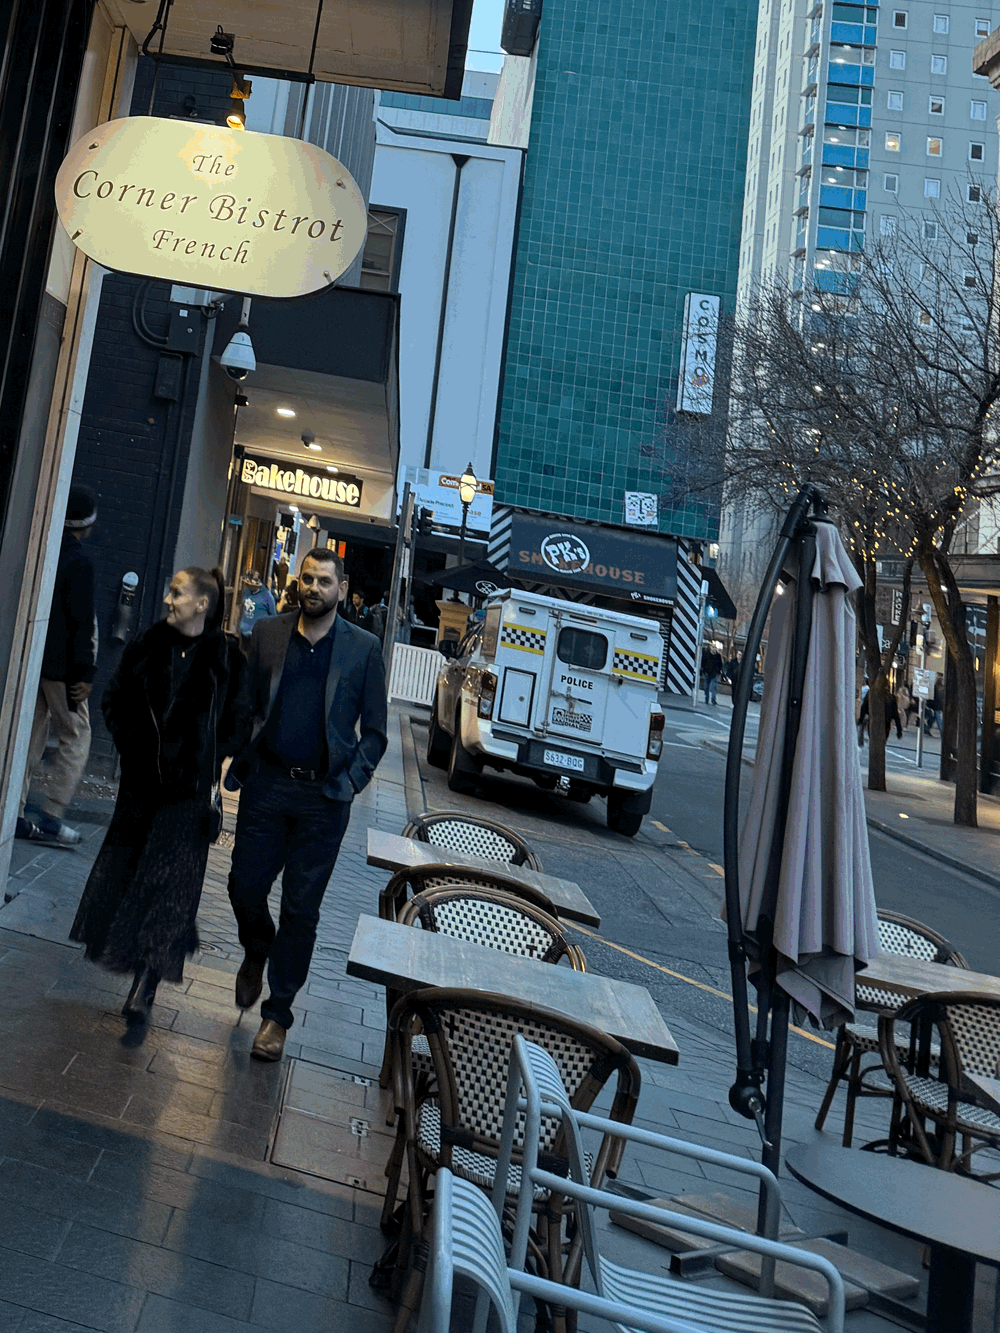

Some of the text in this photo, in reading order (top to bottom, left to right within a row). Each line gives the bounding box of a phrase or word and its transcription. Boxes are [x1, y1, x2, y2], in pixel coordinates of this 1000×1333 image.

[191, 154, 235, 177] The
[73, 170, 346, 243] Corner Bistrot
[152, 228, 251, 264] French
[694, 298, 710, 378] COSMO
[241, 458, 360, 505] Bakehouse
[546, 540, 586, 567] PK's
[560, 674, 594, 690] POLICE
